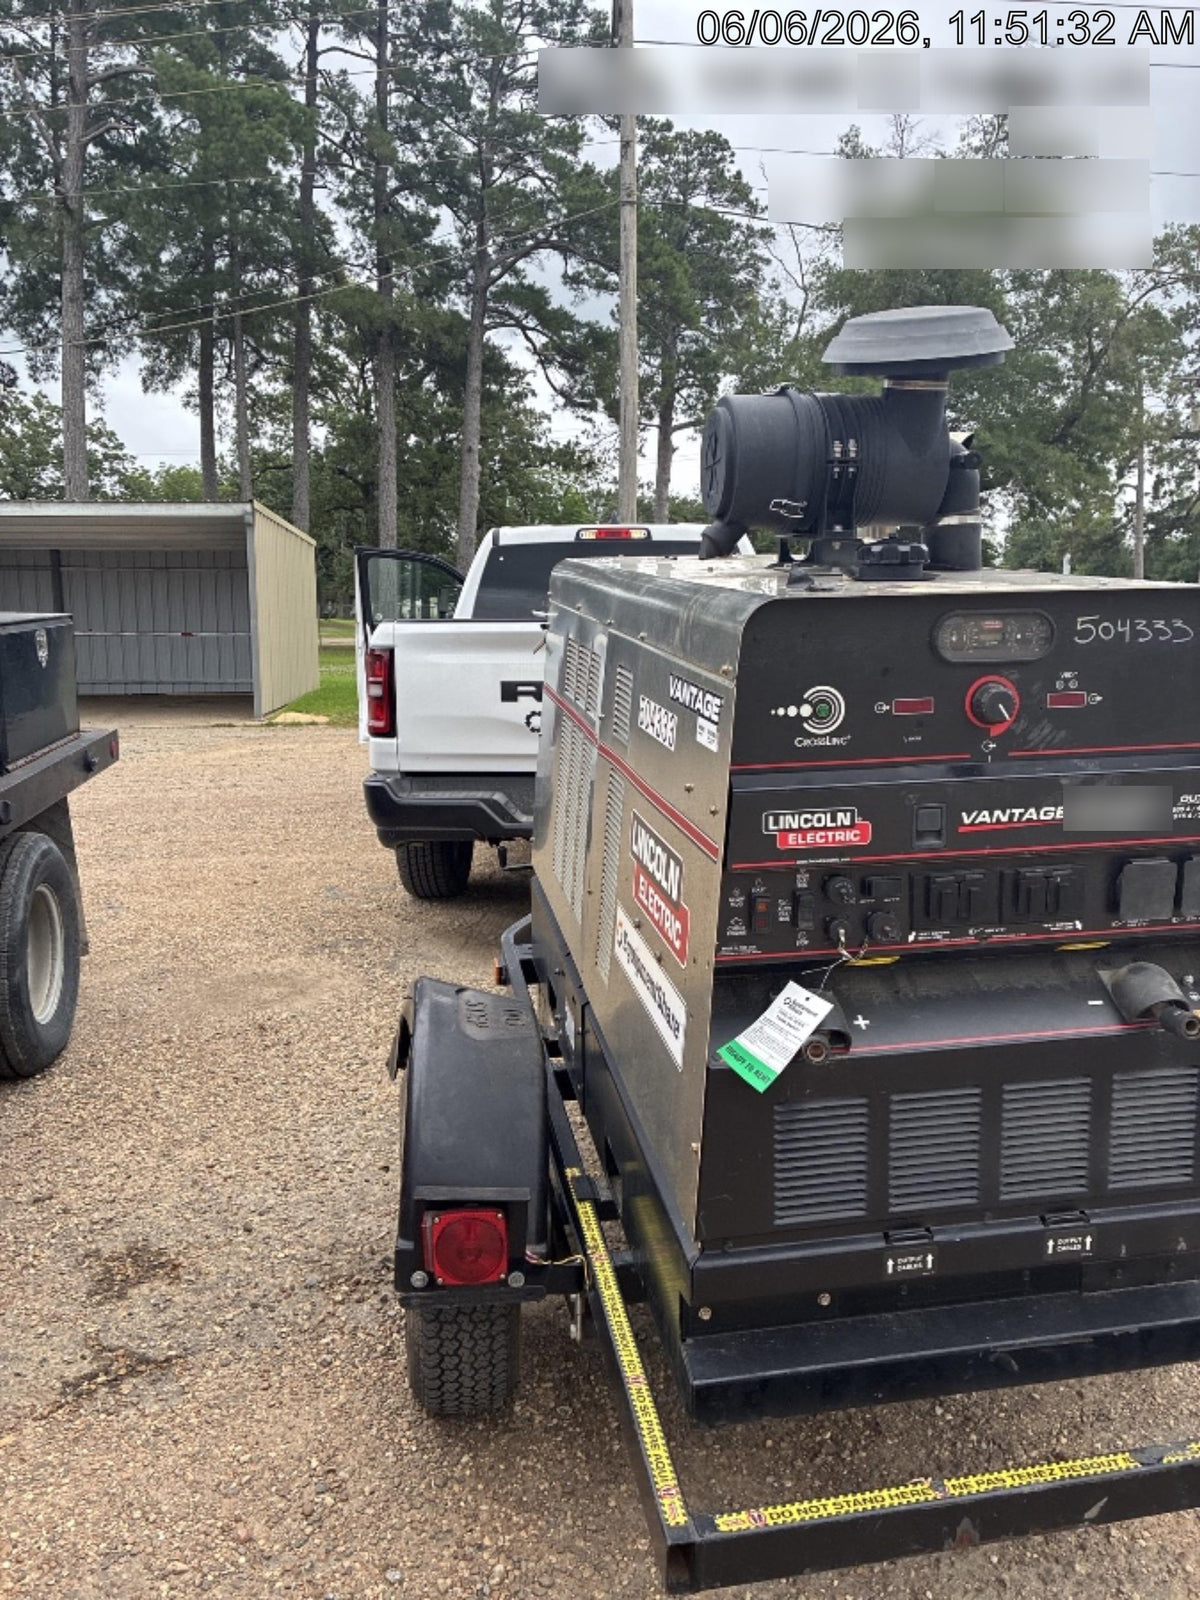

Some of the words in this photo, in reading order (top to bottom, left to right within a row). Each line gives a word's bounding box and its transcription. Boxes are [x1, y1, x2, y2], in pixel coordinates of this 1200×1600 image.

[1073, 614, 1194, 644] 504333
[669, 673, 723, 724] VANTAGE
[768, 811, 852, 831] LINCOLN
[961, 806, 1064, 825] VANTAGE
[788, 830, 861, 845] ELECTRIC
[632, 820, 680, 902] LINCOLN
[638, 873, 682, 950] ELECTRIC
[634, 1387, 646, 1403] NO
[640, 1404, 651, 1417] SE
[643, 1419, 660, 1451] PARE
[975, 1476, 1006, 1489] PAS
[1009, 1468, 1056, 1483] TENEZ
[1060, 1460, 1120, 1475] DEBOUT
[769, 1510, 793, 1521] DO
[795, 1503, 828, 1517] NOT
[831, 1495, 886, 1510] STAND
[888, 1488, 932, 1502] HERE
